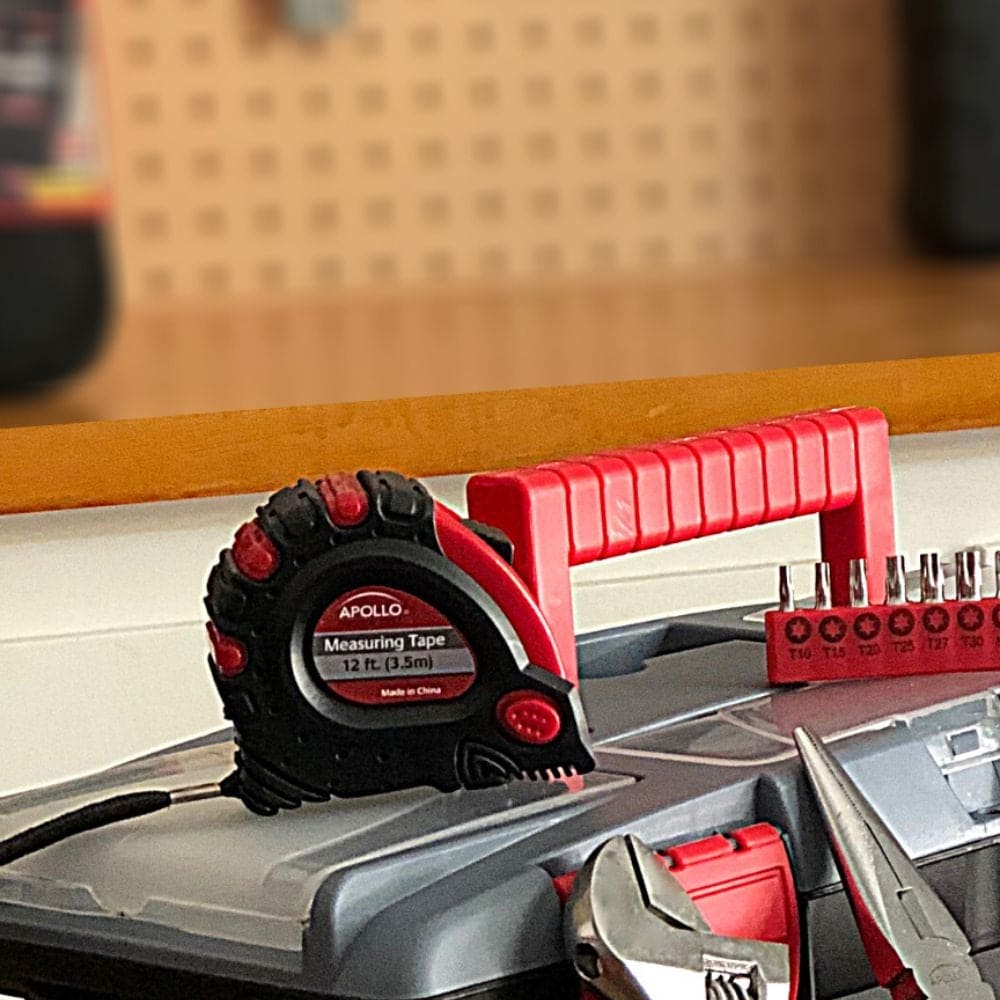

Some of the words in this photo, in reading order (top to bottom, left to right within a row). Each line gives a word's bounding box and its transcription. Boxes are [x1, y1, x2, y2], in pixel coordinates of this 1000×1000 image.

[339, 603, 402, 619] APOLLO
[324, 636, 404, 652] Measuring
[408, 634, 446, 649] Tape
[789, 647, 812, 660] T10
[823, 646, 846, 659] T15
[858, 644, 881, 656] T20
[894, 640, 915, 653] T25
[928, 637, 948, 650] T27
[961, 635, 984, 648] T30
[343, 659, 360, 672] 12
[365, 657, 381, 671] ft.
[385, 656, 433, 672] (3.5m)
[381, 688, 405, 697] Made
[407, 687, 416, 695] in
[417, 686, 441, 695] China
